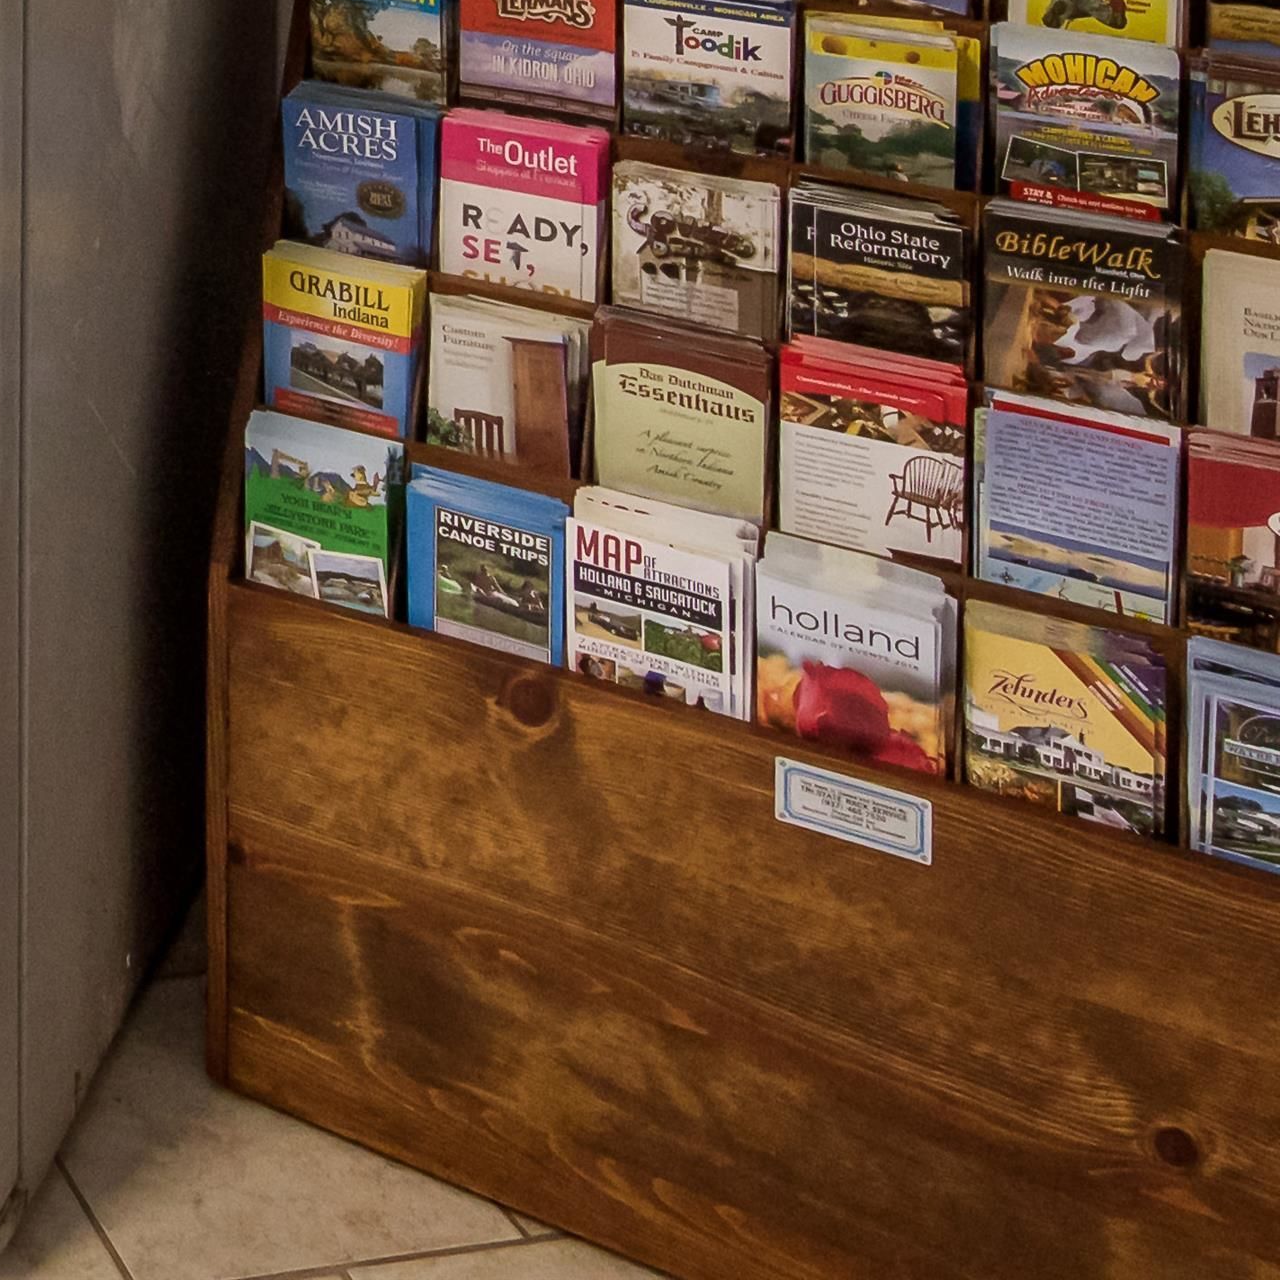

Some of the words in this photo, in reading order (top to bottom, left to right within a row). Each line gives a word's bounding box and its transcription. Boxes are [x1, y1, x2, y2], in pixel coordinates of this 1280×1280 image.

[502, 39, 520, 54] On
[523, 42, 541, 57] the
[692, 27, 724, 38] CAMP
[643, 51, 675, 65] Family
[564, 64, 596, 89] OHIO
[1015, 52, 1161, 104] MOHICAN
[820, 81, 945, 122] GUGGISBERG
[295, 106, 397, 140] AMISH
[298, 128, 398, 161] ACRES
[477, 138, 503, 155] The
[504, 140, 578, 176] Outlet
[830, 233, 951, 269] Reformatory
[840, 222, 886, 242] Ohio
[890, 230, 940, 251] State
[462, 234, 536, 277] SET,
[995, 230, 1161, 279] BibleWalk
[289, 270, 391, 312] GRABILL
[1006, 265, 1044, 282] Walk
[1048, 271, 1077, 287] into
[1082, 276, 1106, 292] the
[1110, 280, 1152, 300] Light
[277, 310, 330, 334] Experience
[332, 322, 349, 336] the
[332, 302, 390, 329] Indiana
[619, 373, 756, 424] Essenhaus
[639, 367, 664, 382] Das
[667, 374, 735, 400] Dutchman
[438, 526, 497, 552] CANOE
[499, 543, 549, 567] TRIPS
[439, 510, 549, 552] RIVERSIDE
[576, 524, 643, 575] MAP
[643, 555, 657, 569] OF
[579, 566, 632, 593] HOLLAND
[645, 585, 717, 617] SAUGATUCK
[643, 568, 720, 600] ATTRACTIONS
[603, 588, 692, 618] MICHIGAN
[771, 595, 920, 661] holland
